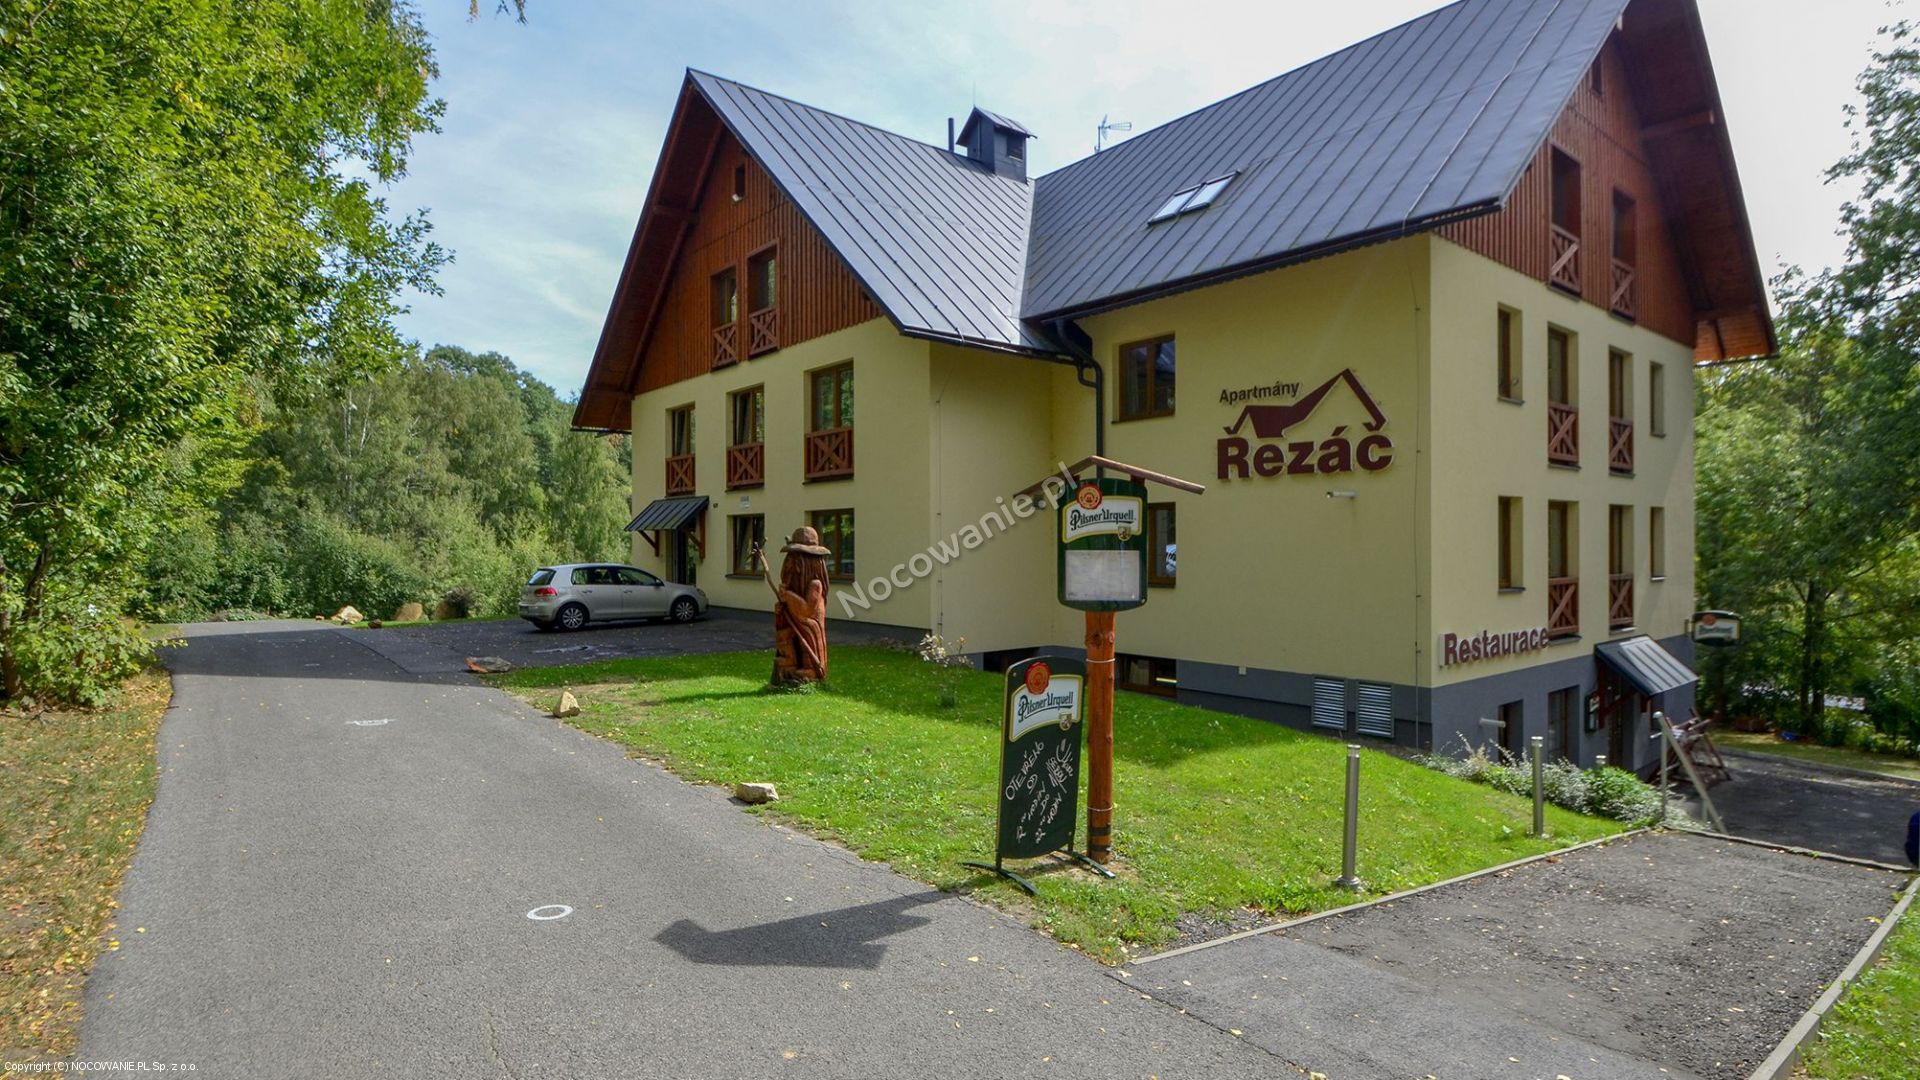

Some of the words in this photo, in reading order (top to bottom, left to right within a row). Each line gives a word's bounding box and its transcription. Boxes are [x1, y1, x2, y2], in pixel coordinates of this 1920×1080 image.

[1219, 381, 1300, 405] Apartmány
[1217, 423, 1393, 480] Řezáč
[1069, 509, 1103, 531] Pilsner
[1102, 508, 1134, 525] Urquell
[1442, 627, 1549, 666] Restaurace
[1018, 695, 1048, 723] Pilsner
[1046, 691, 1074, 710] Urquell
